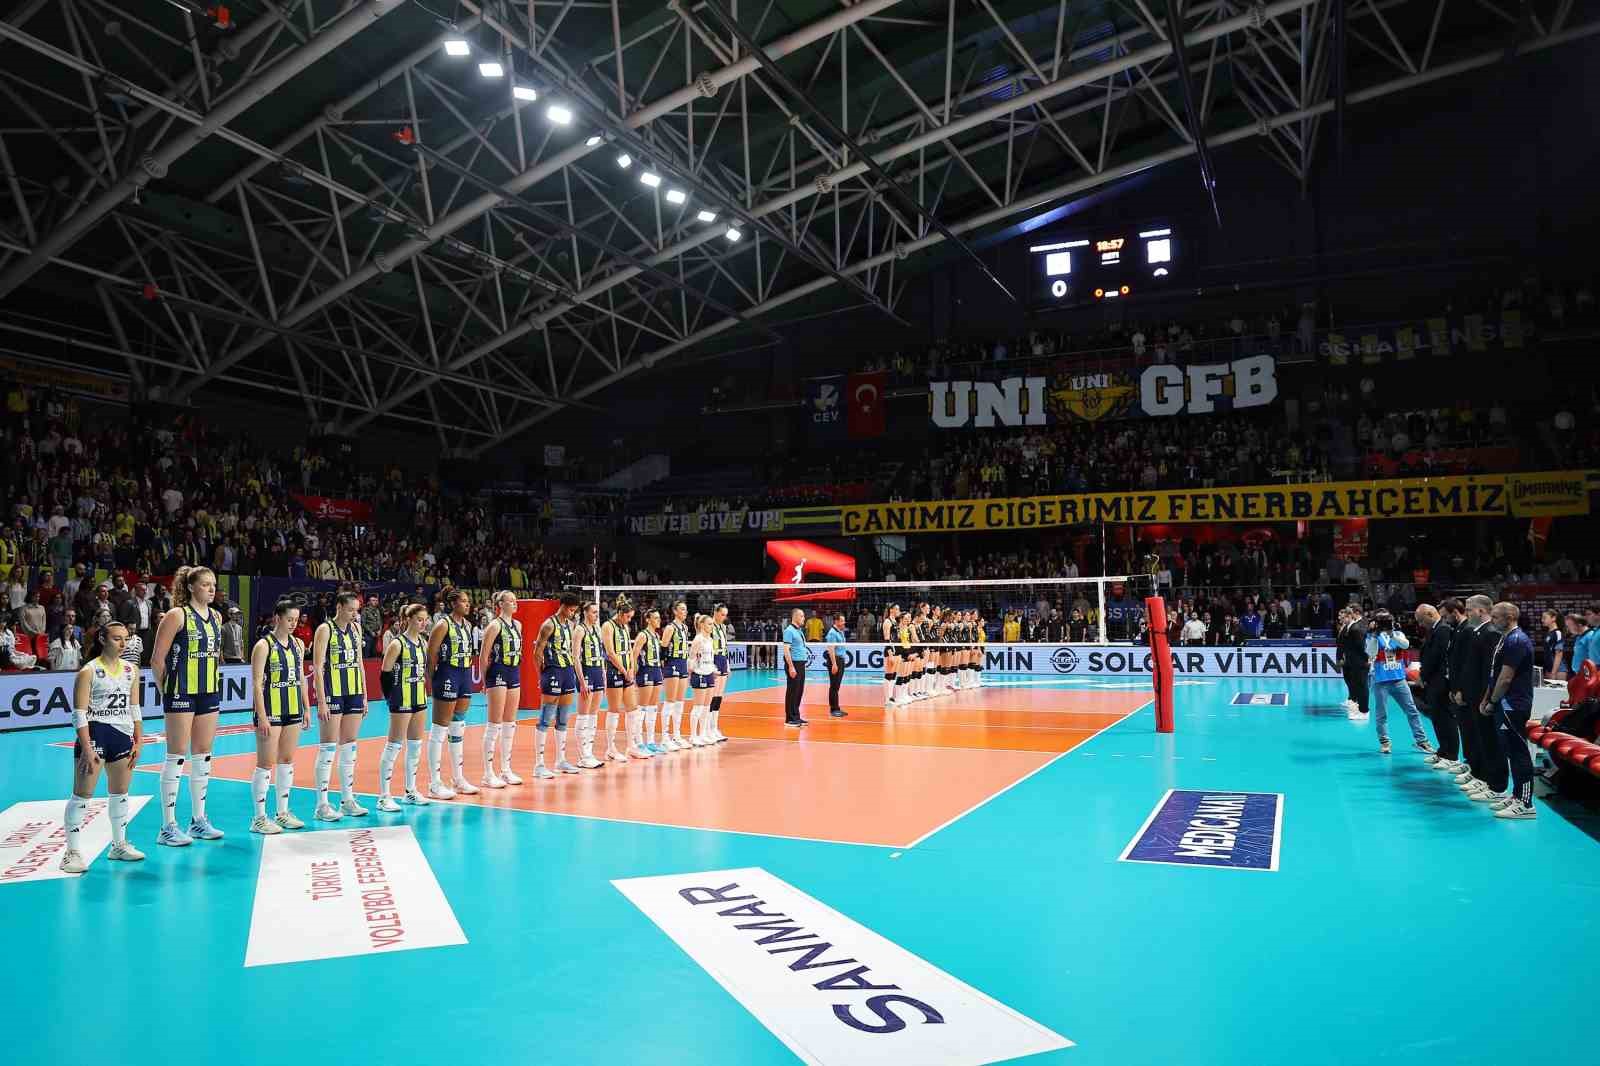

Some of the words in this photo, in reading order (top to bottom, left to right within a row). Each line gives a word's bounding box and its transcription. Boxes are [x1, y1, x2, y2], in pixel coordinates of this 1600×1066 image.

[1053, 281, 1067, 297] 0
[1095, 289, 1103, 297] 0
[1121, 286, 1129, 294] 0
[1071, 373, 1110, 391] UNI
[1139, 354, 1279, 417] GFB
[928, 376, 1048, 429] UNI
[814, 410, 840, 424] CEV
[844, 504, 975, 534] CANIMIZ
[1167, 476, 1506, 521] FENERBAHÇEMİZ
[627, 513, 691, 533] NEVER
[699, 511, 743, 531] GIVE
[748, 510, 780, 529] UP!
[207, 637, 215, 649] 5
[985, 646, 1033, 671] MİN
[1214, 647, 1342, 674] VİTAMİN
[108, 693, 127, 709] 23
[305, 860, 343, 901] TÜRKİYE
[360, 885, 406, 948] VOLEYBOL
[677, 882, 947, 1034] SANMAR
